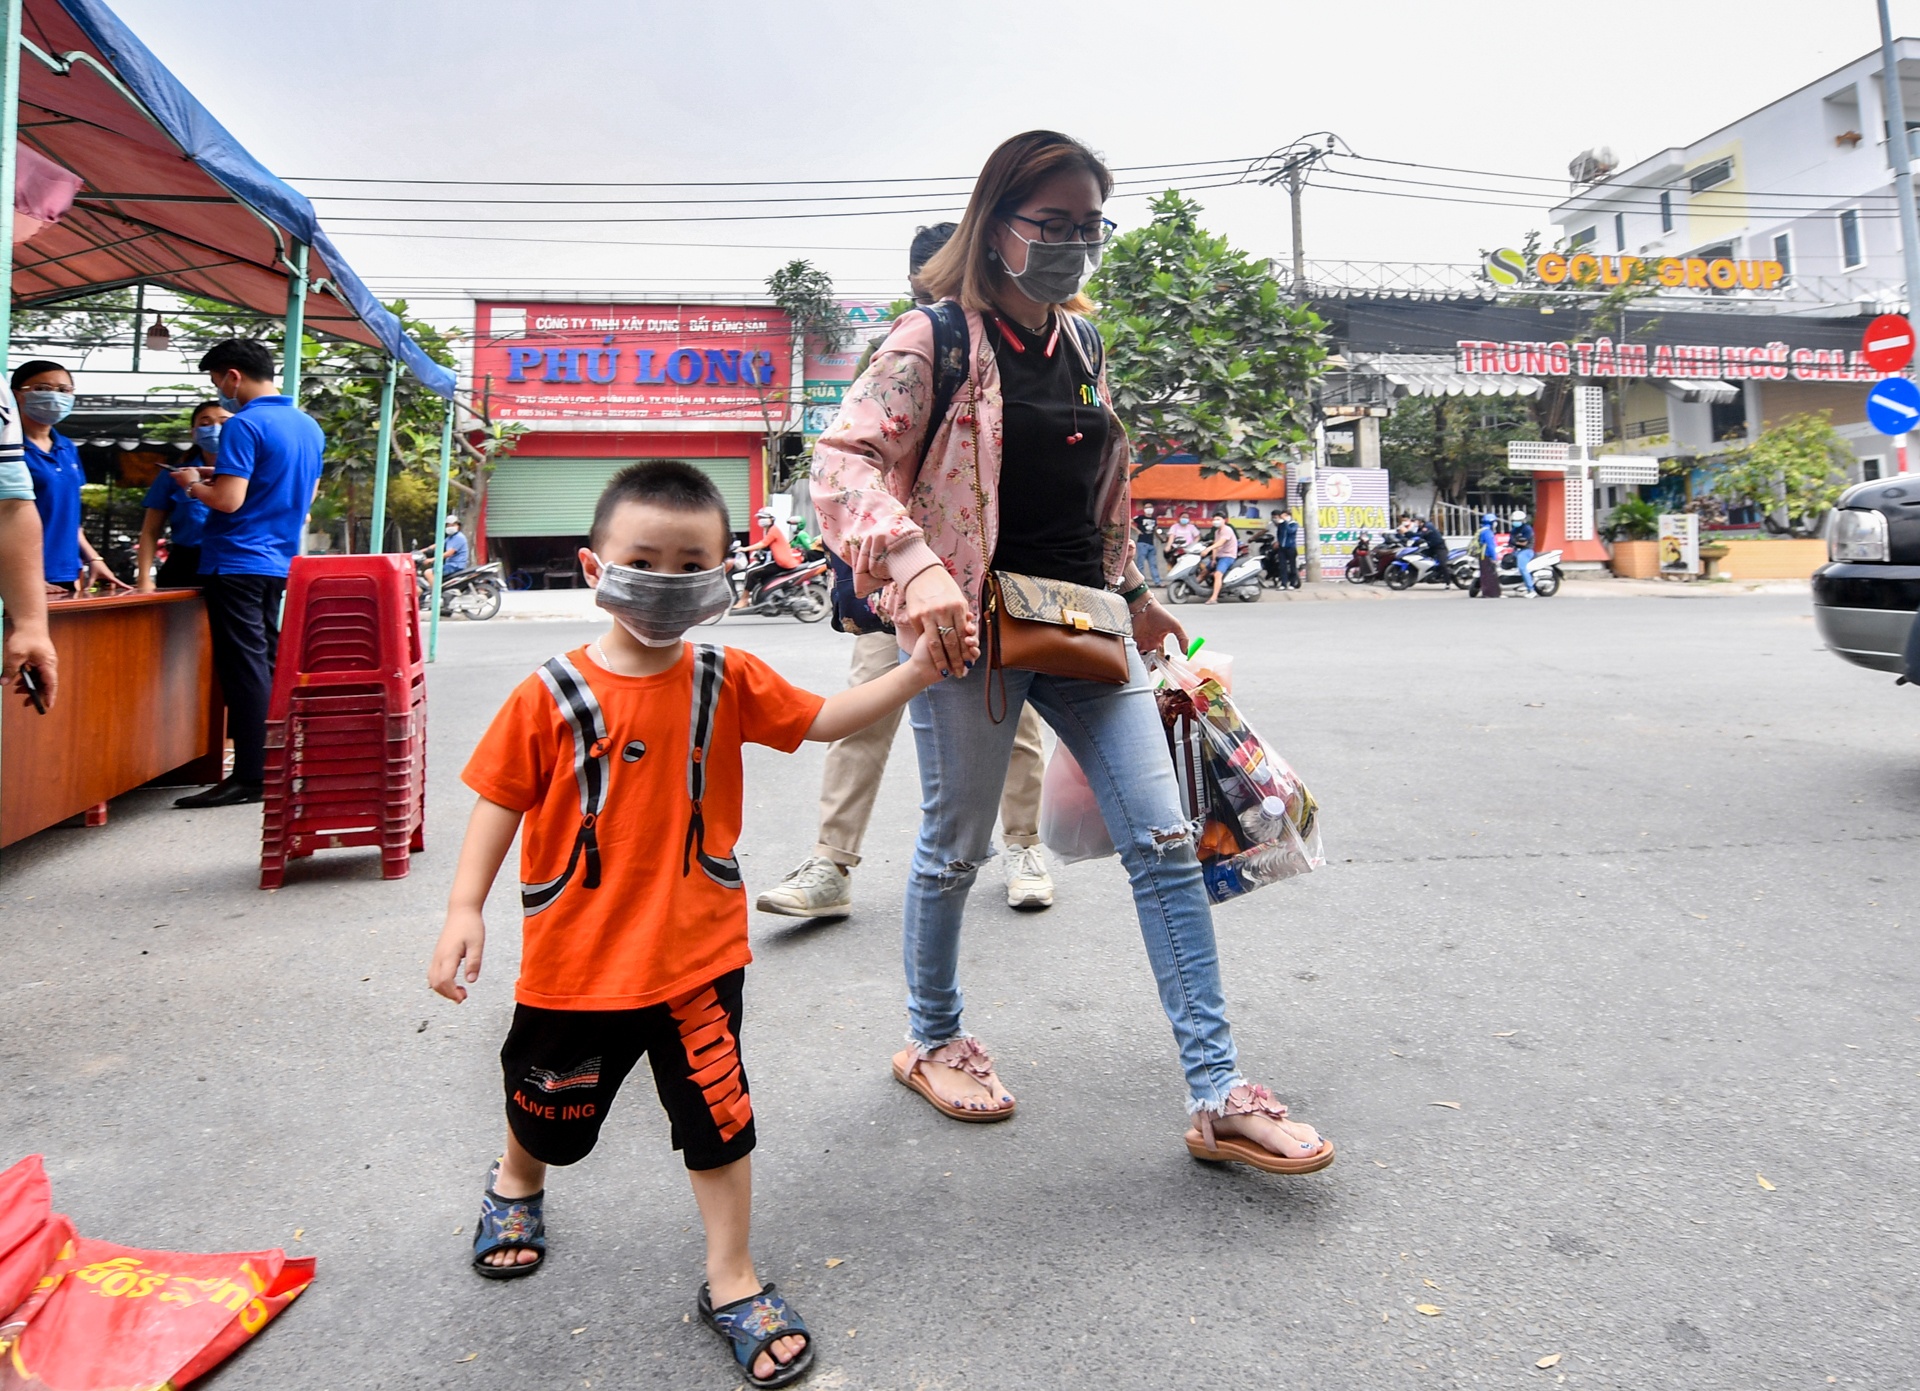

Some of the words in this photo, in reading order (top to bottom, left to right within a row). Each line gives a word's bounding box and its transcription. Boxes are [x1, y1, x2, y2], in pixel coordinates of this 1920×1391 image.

[1657, 256, 1785, 290] GROUP
[535, 315, 569, 330] CÔNG
[571, 318, 588, 329] TY
[622, 316, 645, 331] XÂY
[506, 335, 621, 384] PHÚ
[635, 348, 776, 386] LONG
[1457, 340, 1570, 375] TRUNG
[1573, 337, 1648, 377] TÂM
[1652, 345, 1721, 379] ANH
[1722, 341, 1790, 380] NGỮ
[1342, 506, 1387, 528] YOGA
[513, 1090, 556, 1120] ALIVE
[562, 1103, 596, 1120] ING
